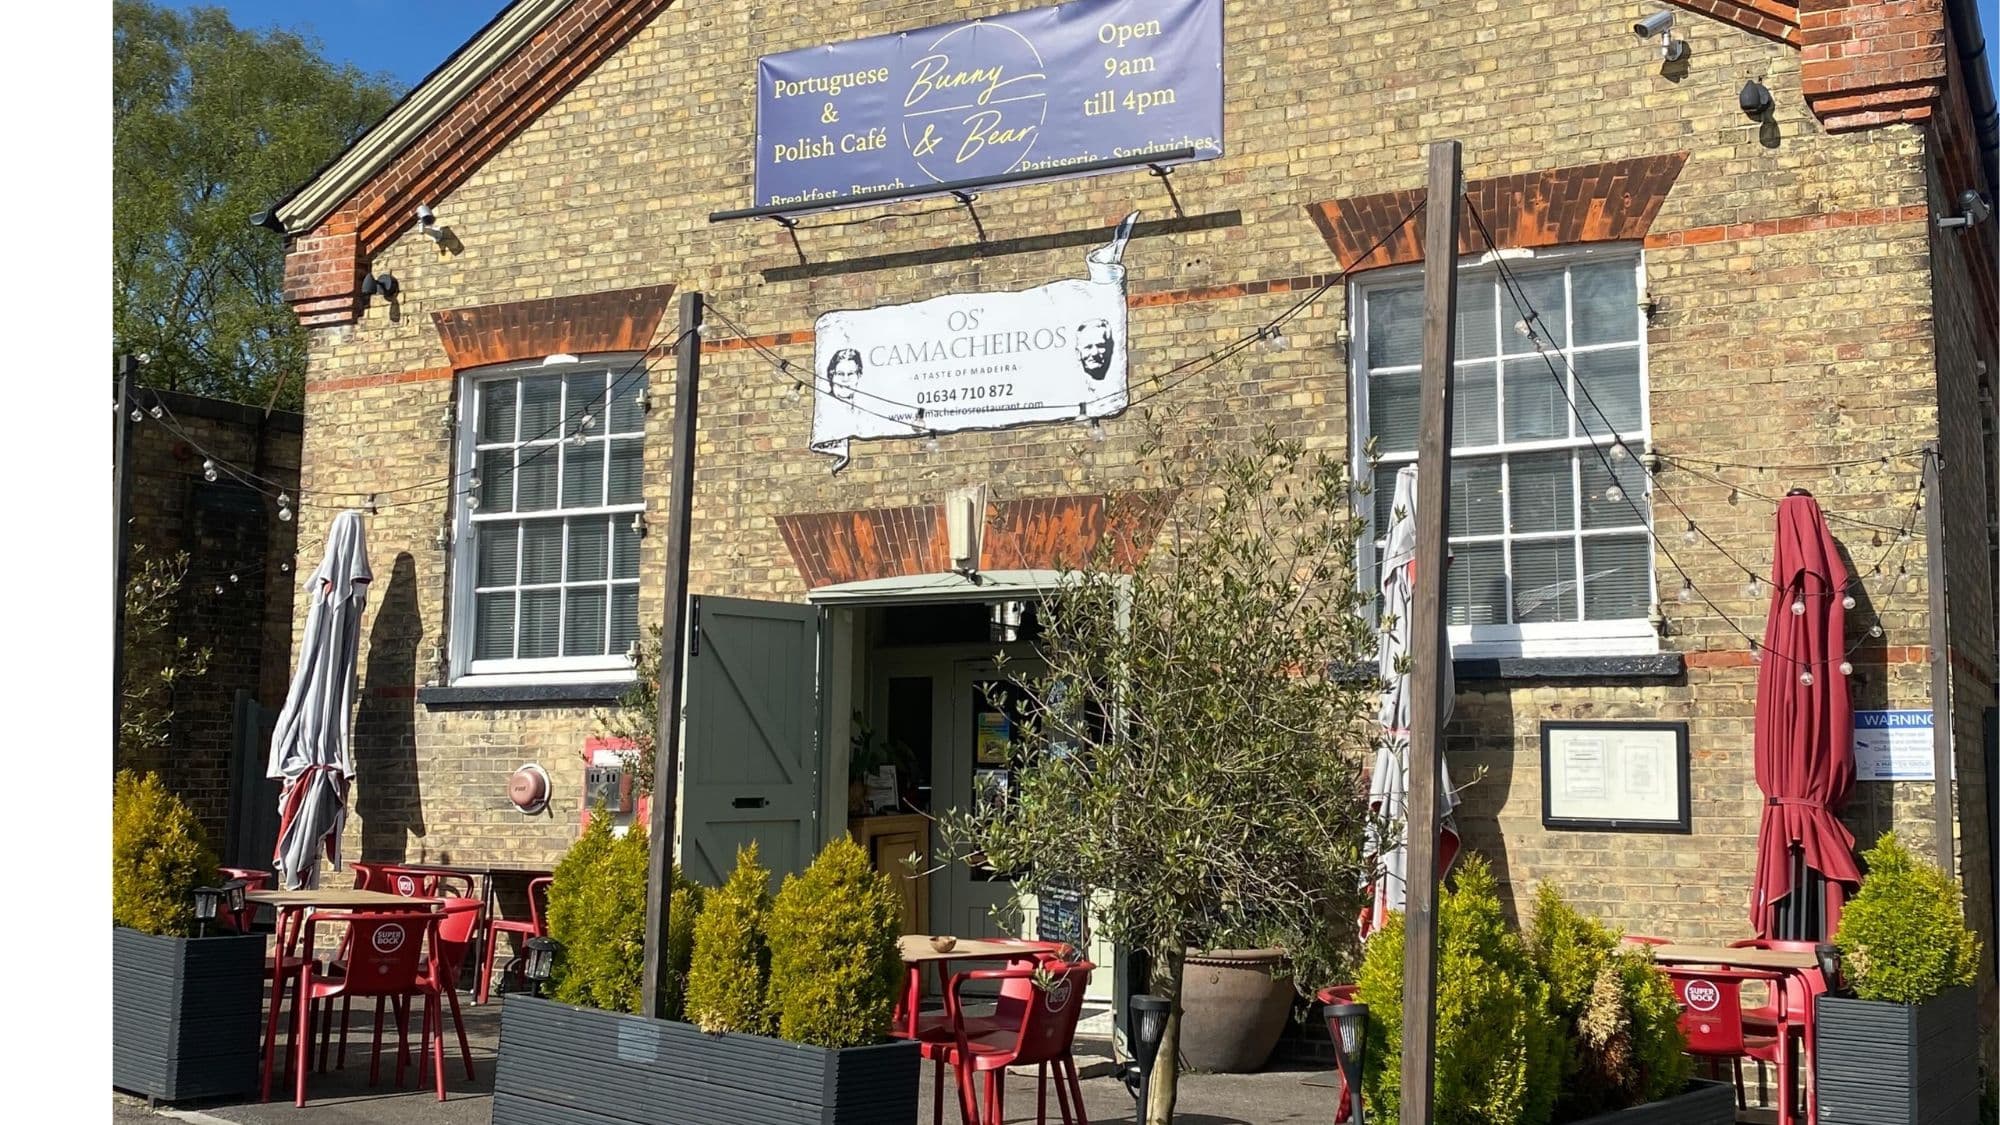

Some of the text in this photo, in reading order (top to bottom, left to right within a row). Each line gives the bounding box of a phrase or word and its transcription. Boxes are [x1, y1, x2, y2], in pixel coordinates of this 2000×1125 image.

[1098, 19, 1162, 48] Open
[1104, 56, 1156, 78] 9am
[774, 67, 889, 99] Portuguese
[904, 54, 1046, 107] Bunny
[821, 102, 840, 123] &
[1083, 88, 1176, 116] till 4pm
[774, 126, 887, 163] Polish Café
[912, 110, 1037, 164] & Bear
[869, 326, 1068, 367] CAMACHEIROS
[913, 373, 919, 381] A
[922, 370, 952, 380] TASTE
[970, 363, 1018, 375] MADEIRA
[916, 383, 1014, 405] 01634 710 872
[888, 400, 1044, 422] www.macheirosrestaurant.com
[377, 931, 401, 939] SUPER
[377, 937, 398, 945] BOCK
[1689, 986, 1714, 996] SUPER
[1690, 994, 1714, 1002] BOCK
